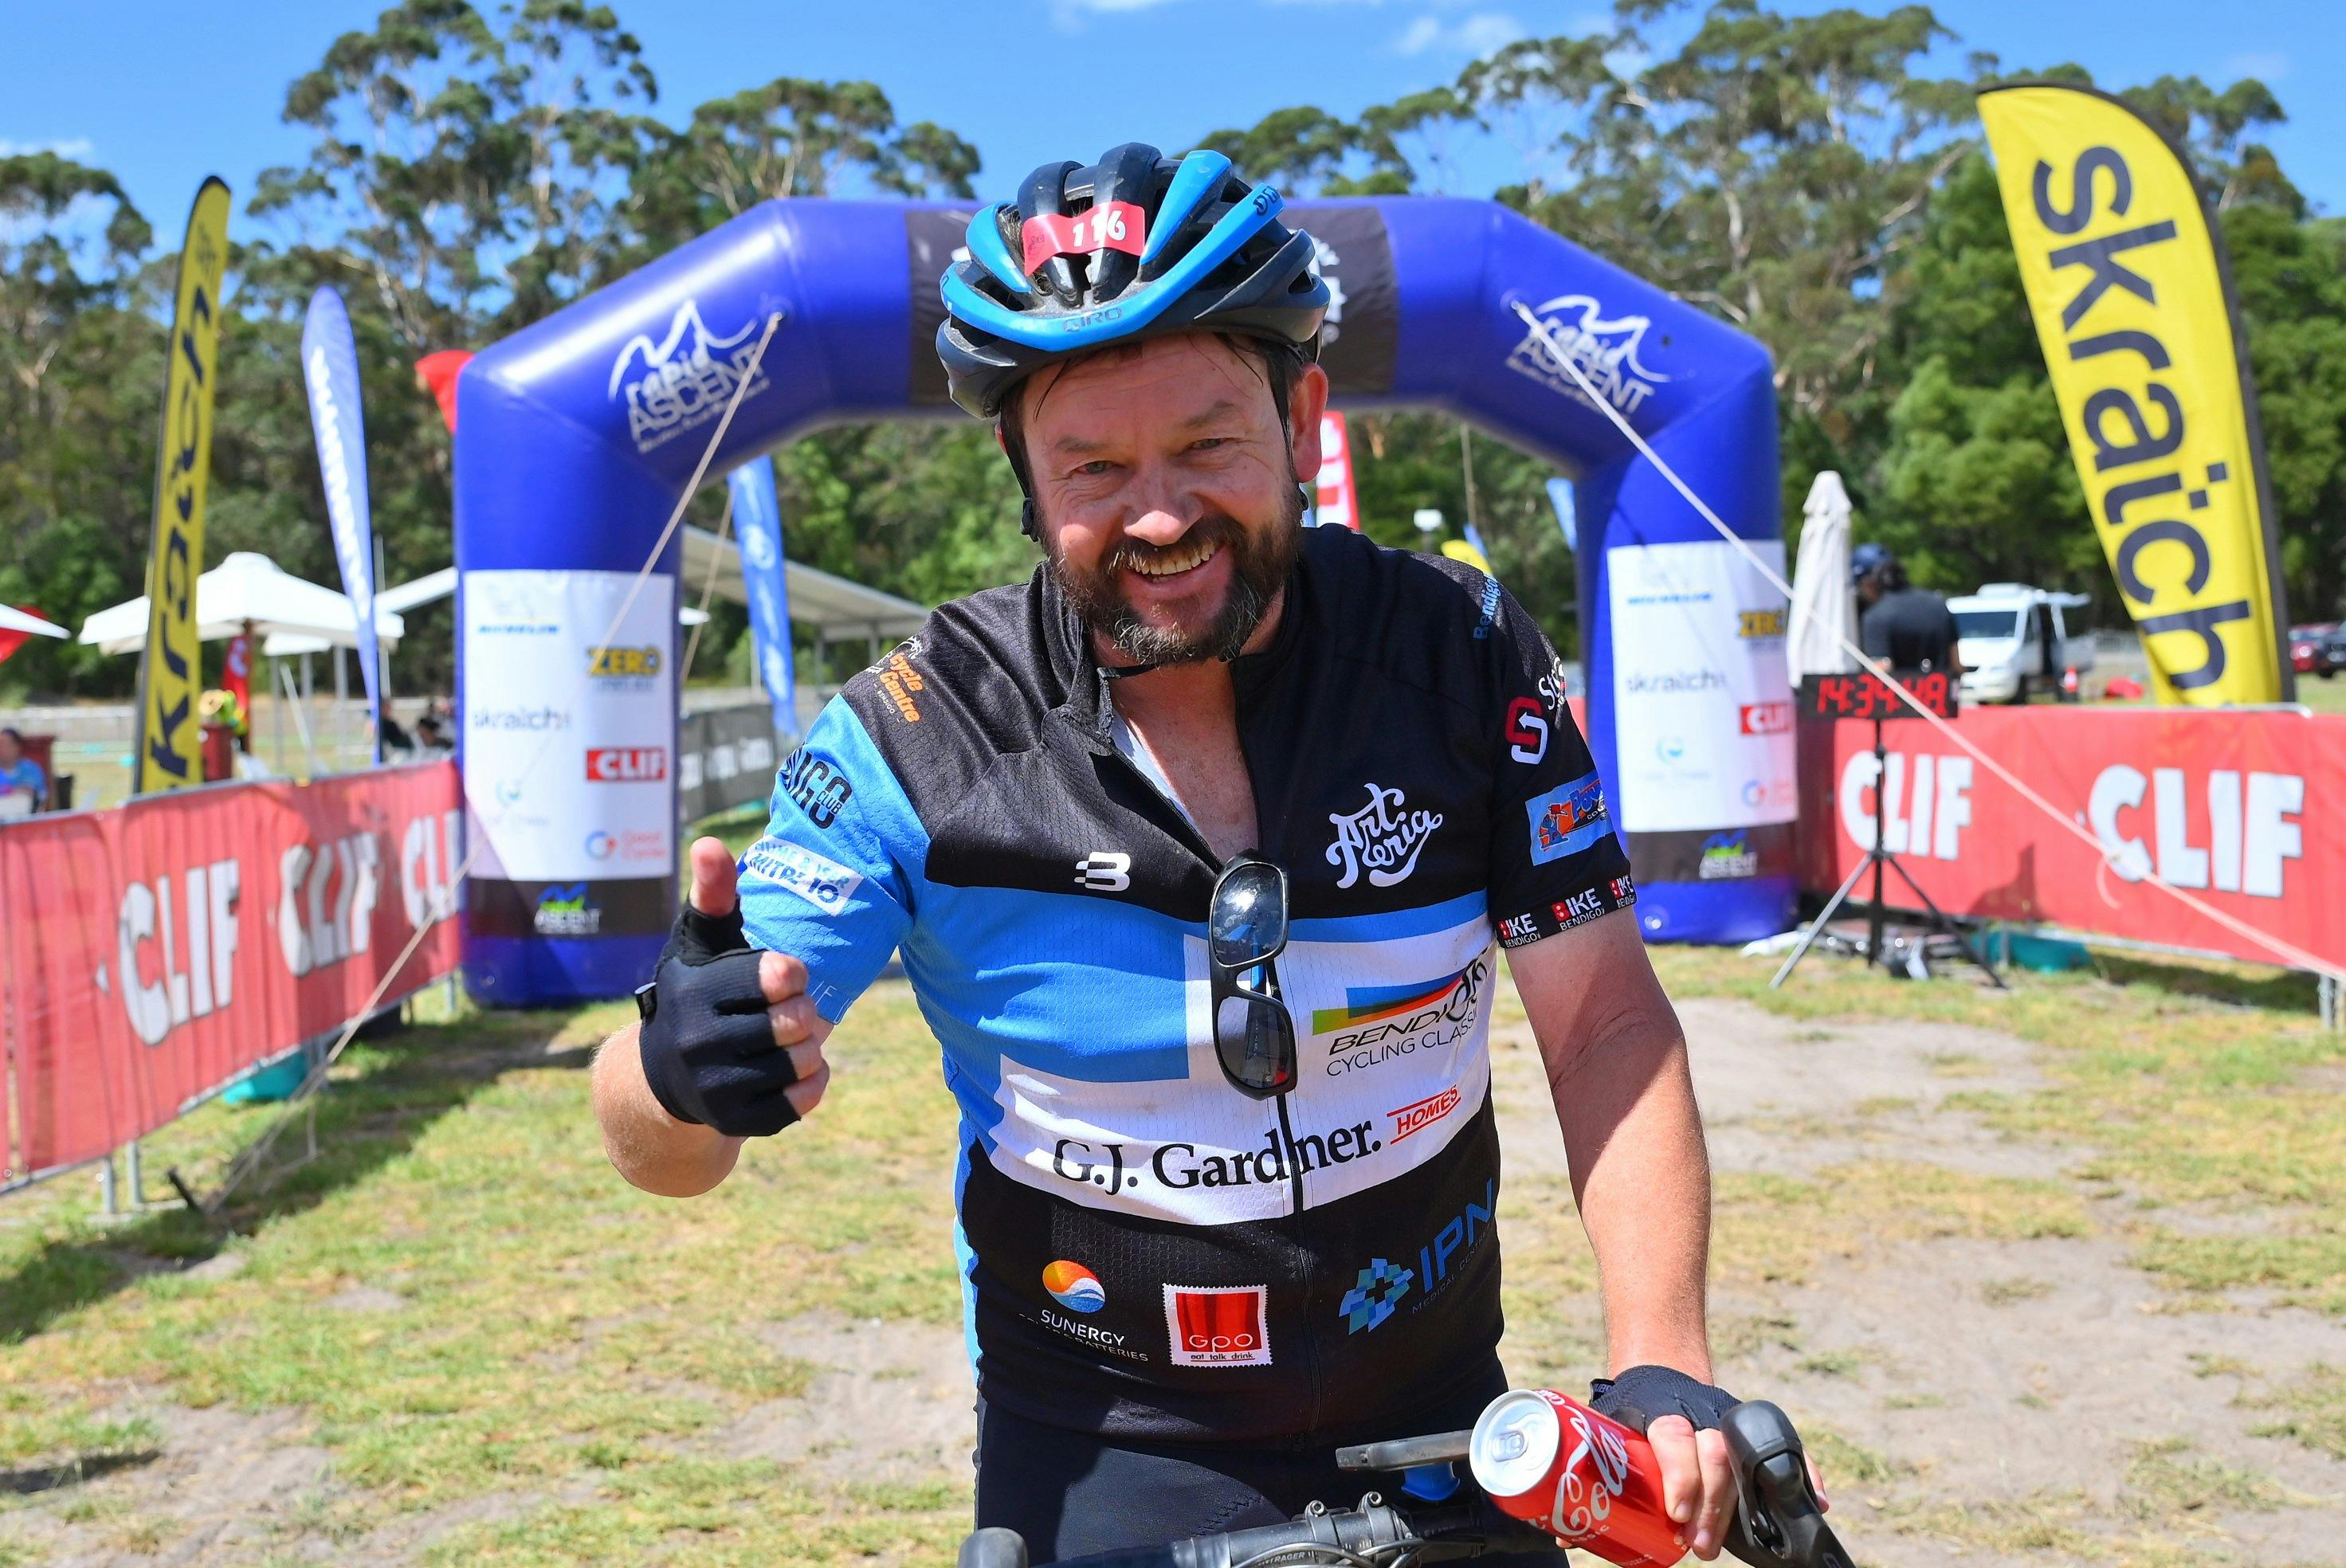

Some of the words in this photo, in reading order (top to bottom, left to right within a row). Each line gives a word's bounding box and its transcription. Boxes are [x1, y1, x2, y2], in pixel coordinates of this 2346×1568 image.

[1072, 210, 1127, 247] 116
[1063, 308, 1123, 332] GIRO
[150, 285, 210, 787] kratch
[586, 646, 665, 676] ZERO
[595, 751, 665, 776] CLIF
[817, 791, 843, 814] CLUB
[1839, 751, 1974, 860] CLIF
[2088, 765, 2305, 898] CLIF
[402, 809, 461, 928] CLI
[279, 832, 379, 977] CLIF
[808, 877, 839, 904] 10
[1551, 888, 1602, 923] BIKE
[1497, 912, 1538, 940] BIKE
[119, 860, 238, 1047] CLIF
[1326, 1038, 1416, 1076] CYCLING
[1053, 1139, 1138, 1195] G.J.
[1152, 1120, 1382, 1189] Gardner.
[1396, 1084, 1458, 1135] HOMES
[1420, 1177, 1493, 1294] IPN
[1040, 1309, 1125, 1347] SUNERGY
